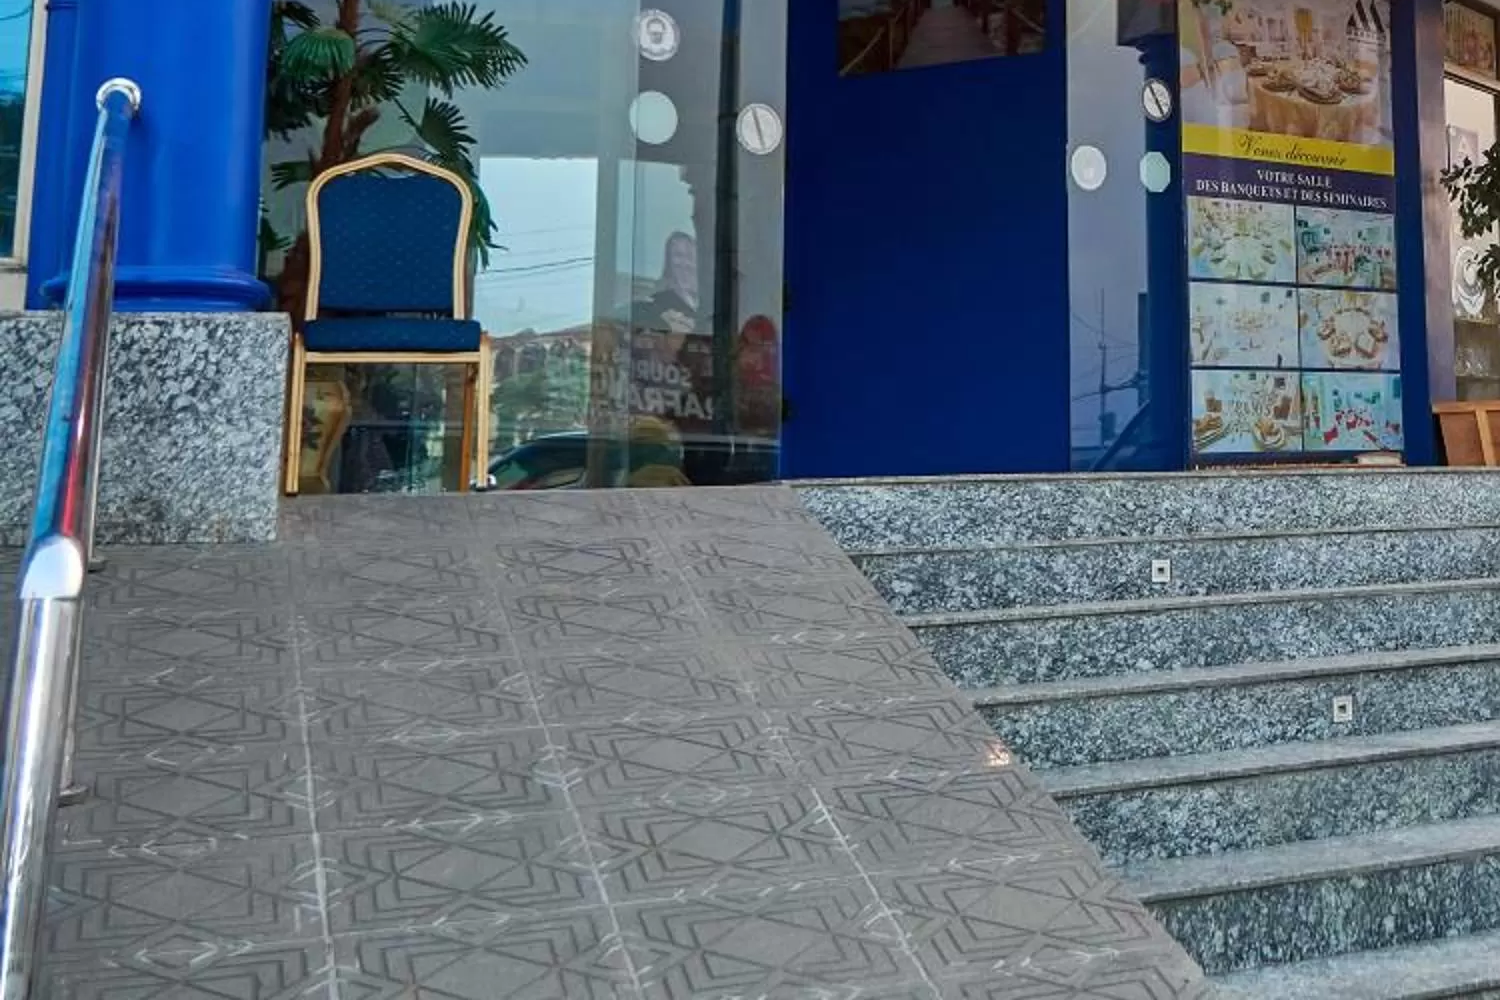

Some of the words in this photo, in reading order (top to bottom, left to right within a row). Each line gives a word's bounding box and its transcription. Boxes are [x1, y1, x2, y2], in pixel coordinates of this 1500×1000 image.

[1256, 169, 1295, 184] VOTRE
[1296, 173, 1333, 189] SALLE
[1196, 179, 1219, 193] DES
[1220, 180, 1282, 200] BANQUETS
[1283, 187, 1299, 201] ET
[1301, 189, 1322, 203] DES
